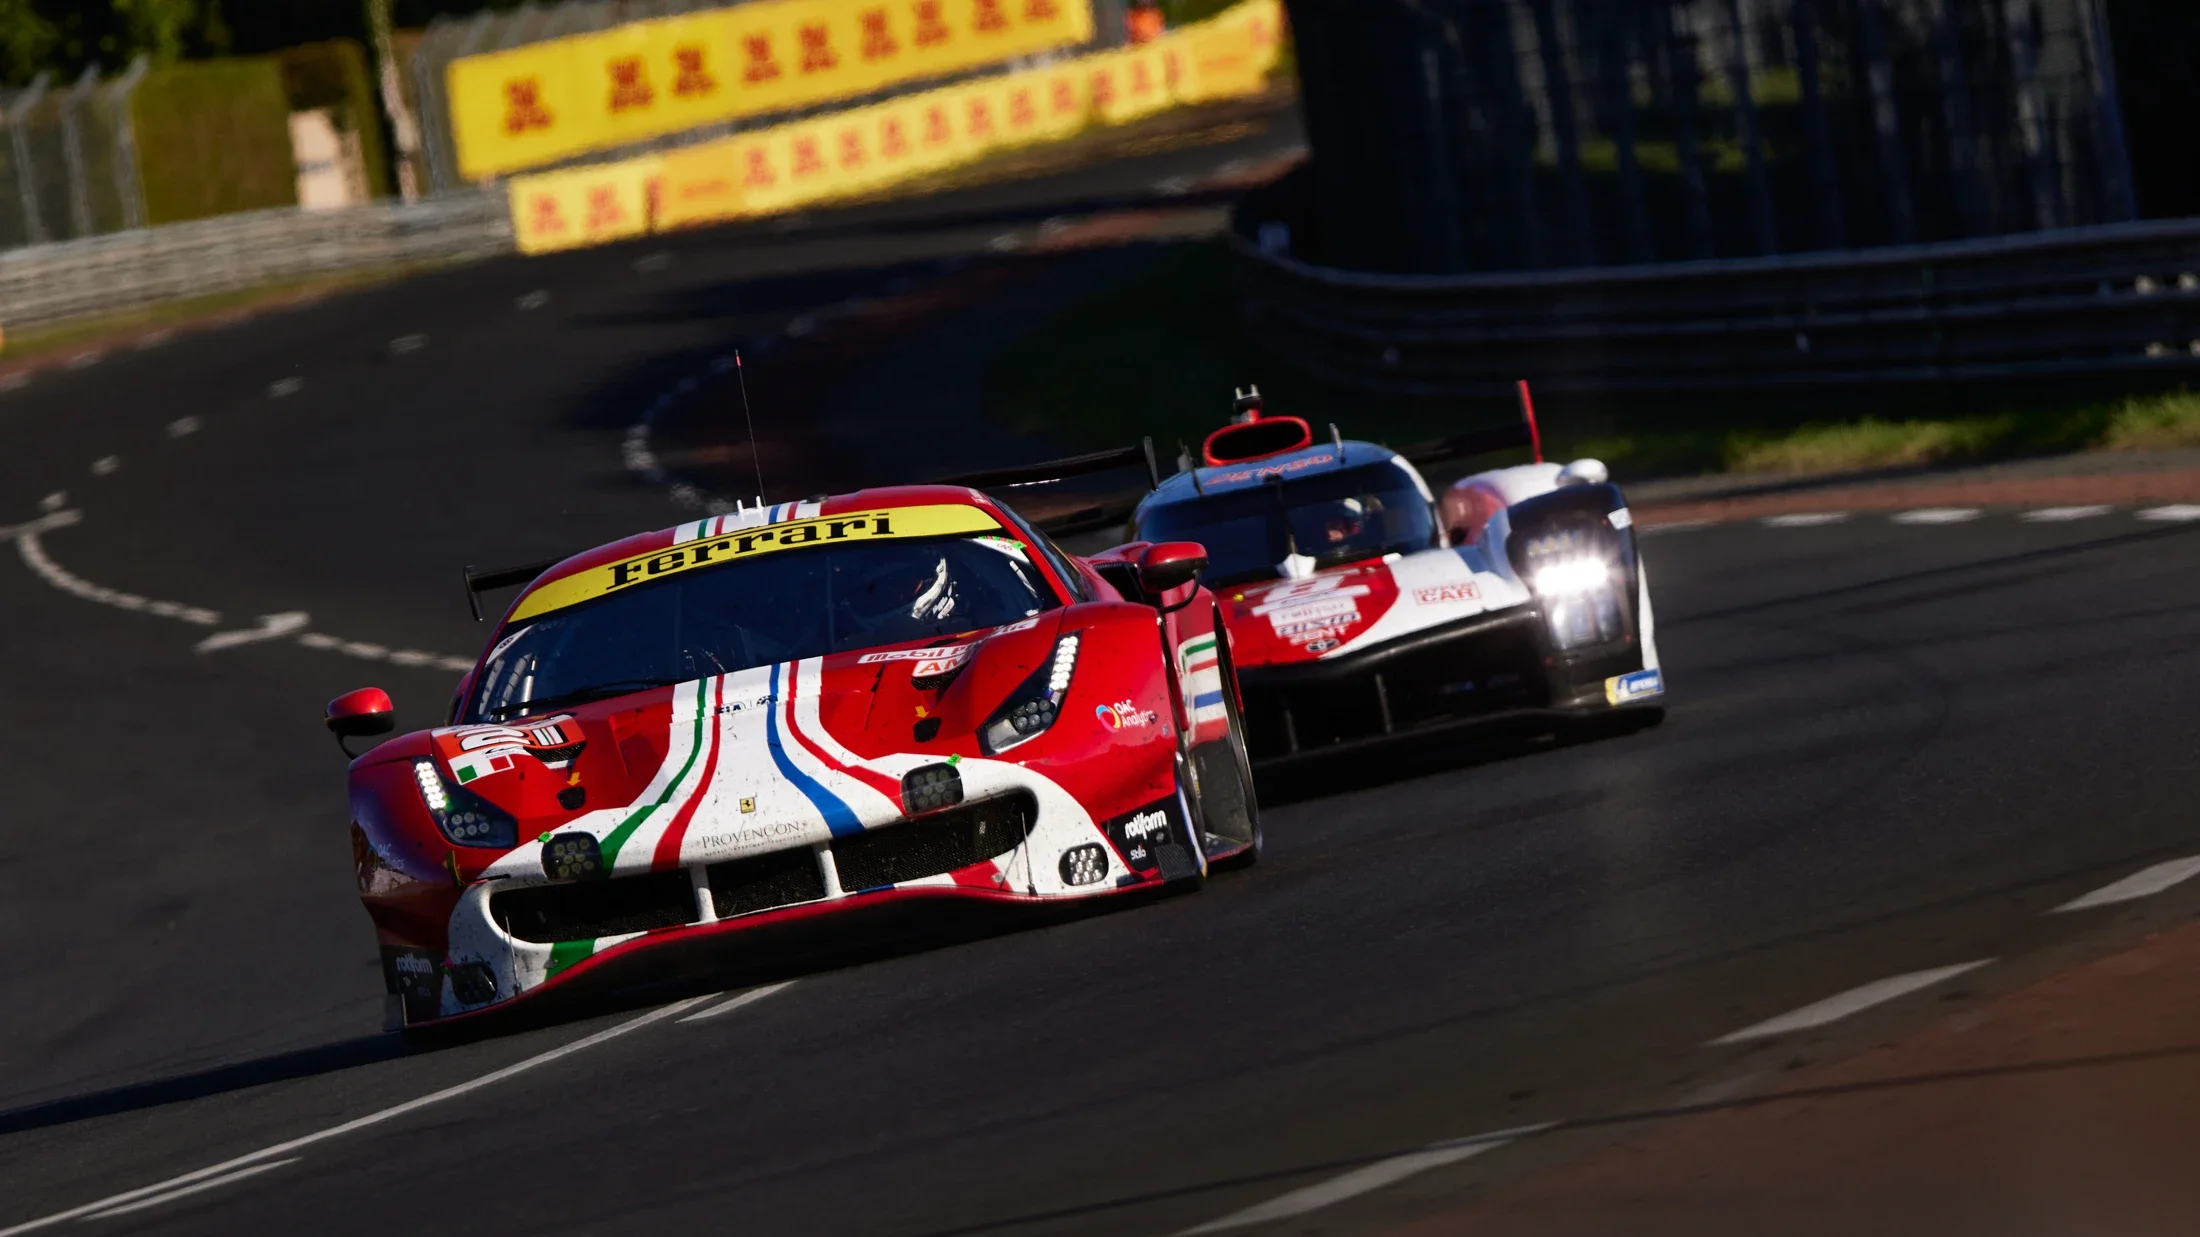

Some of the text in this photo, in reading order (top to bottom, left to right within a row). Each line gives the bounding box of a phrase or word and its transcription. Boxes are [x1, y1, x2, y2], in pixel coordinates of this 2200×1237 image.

[606, 512, 895, 591] Ferrari
[702, 821, 799, 848] PROVENCON
[1125, 810, 1167, 840] rotiform
